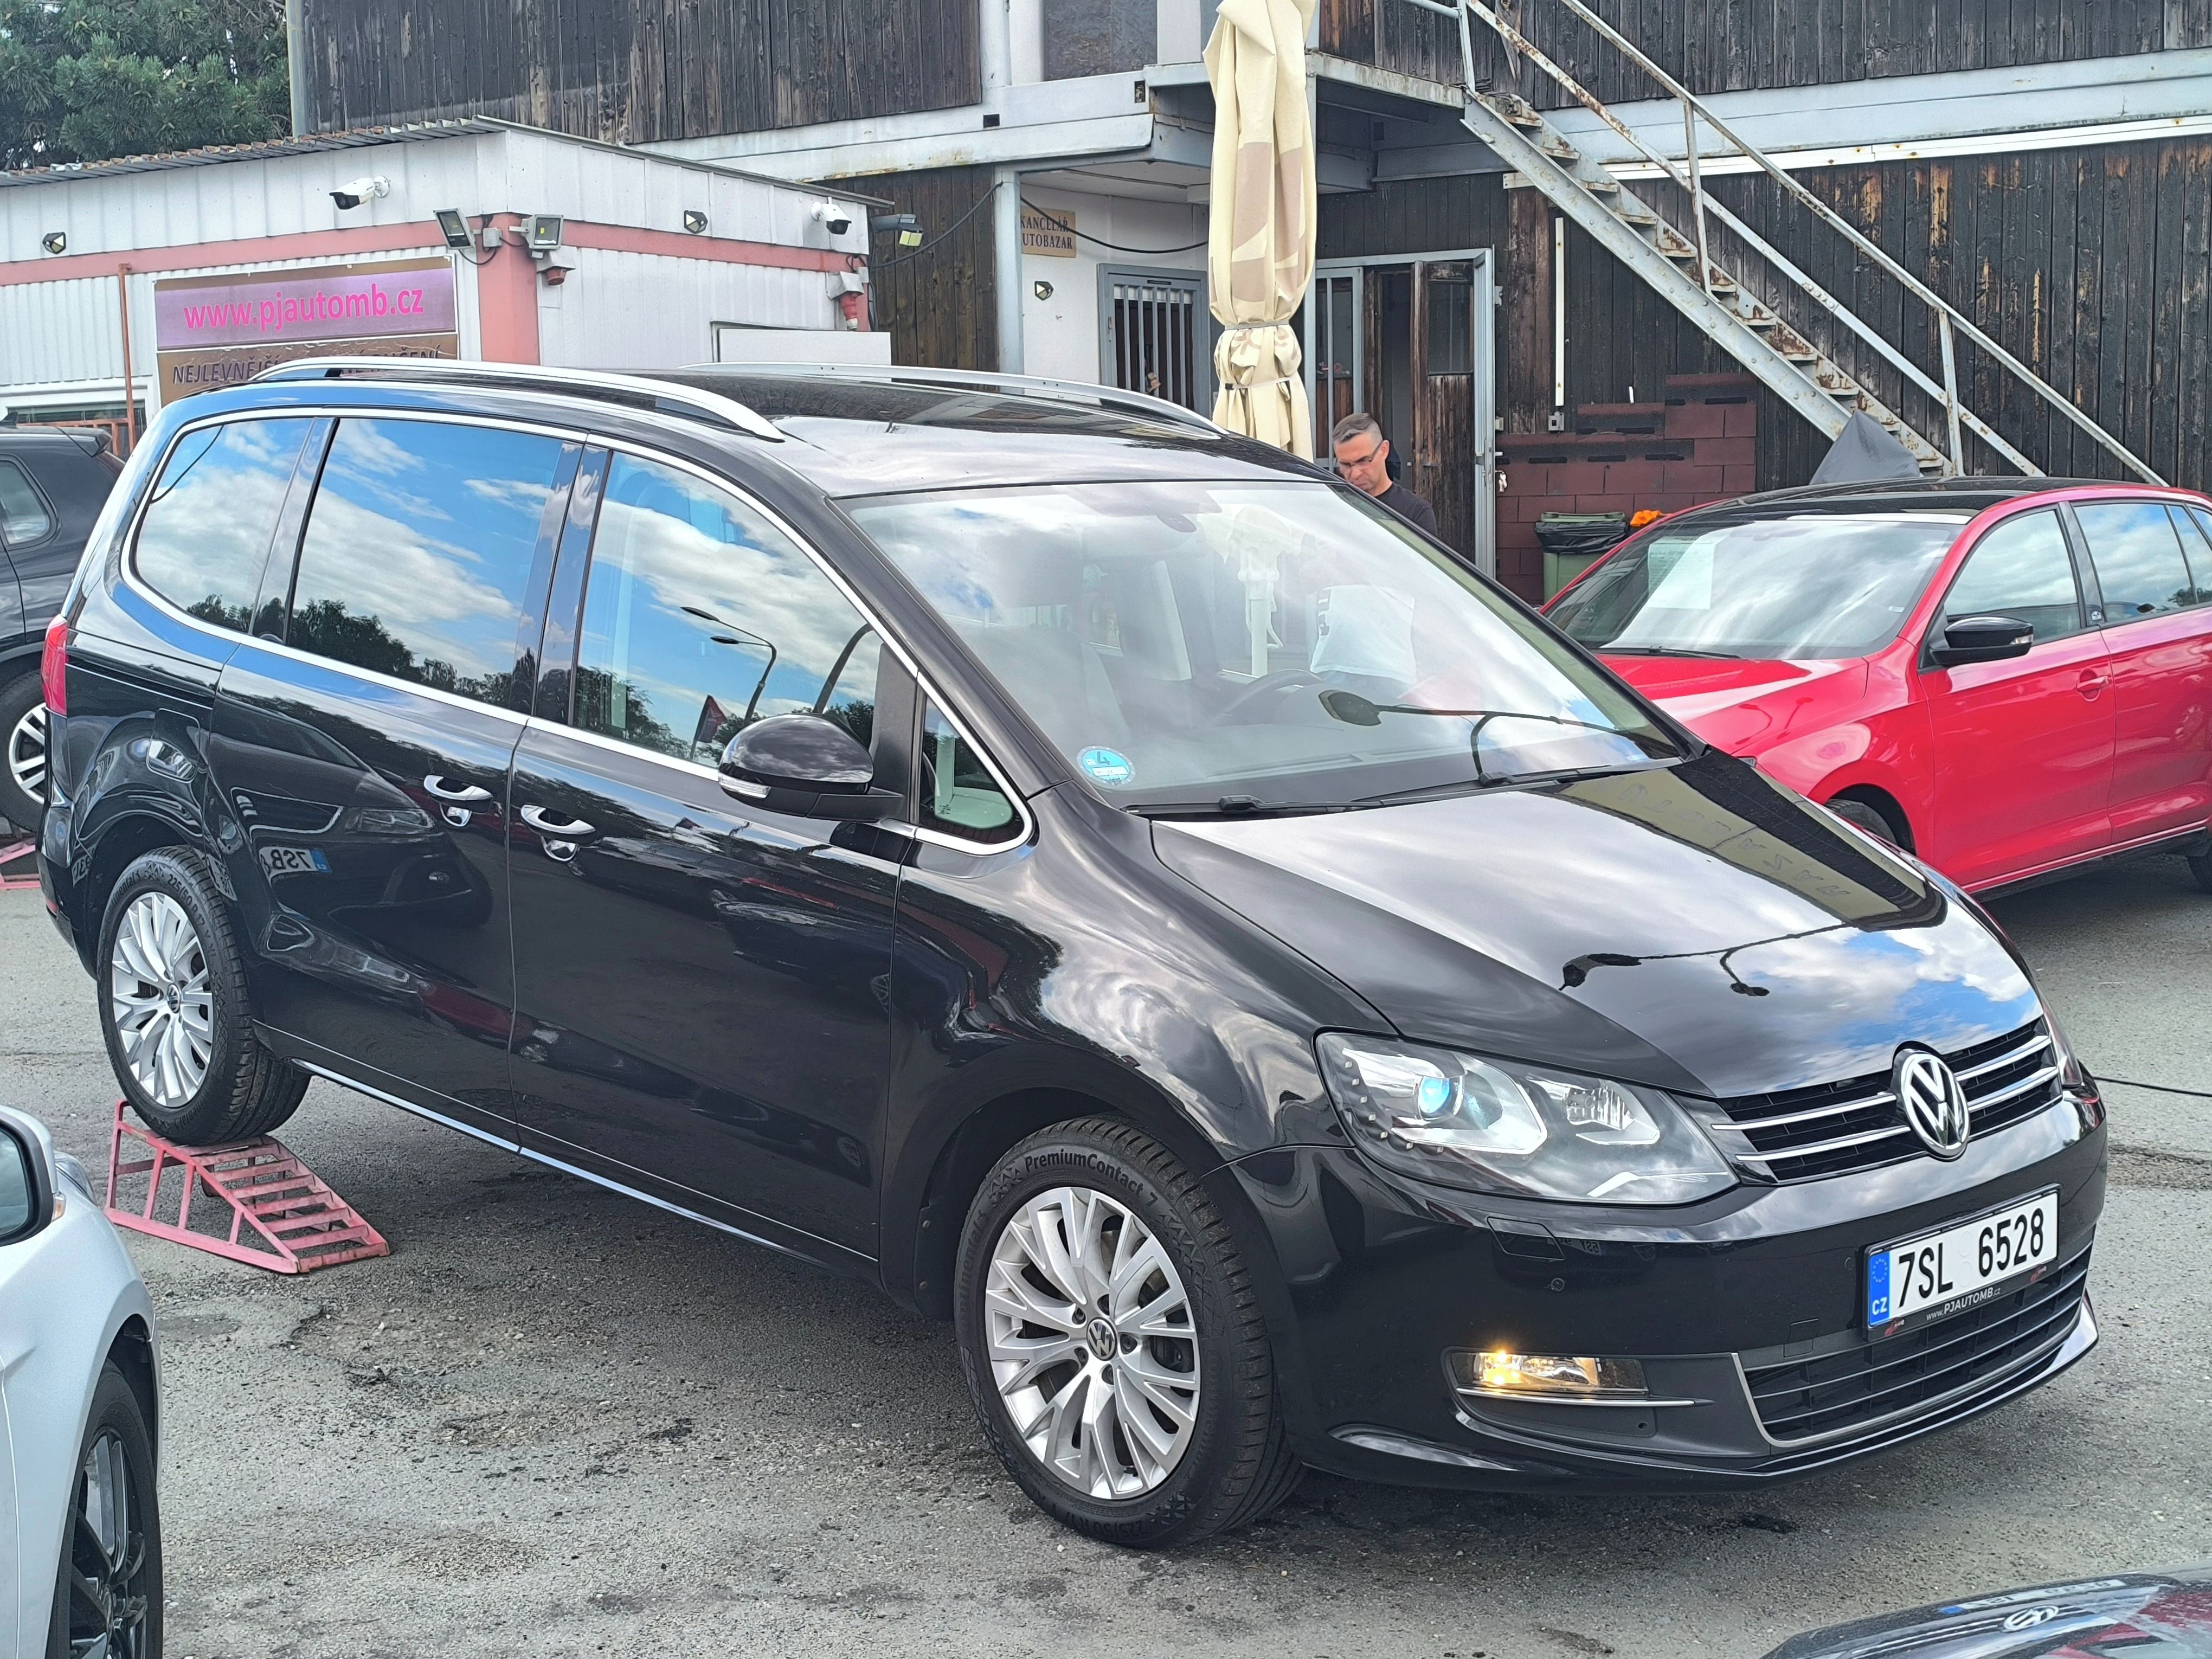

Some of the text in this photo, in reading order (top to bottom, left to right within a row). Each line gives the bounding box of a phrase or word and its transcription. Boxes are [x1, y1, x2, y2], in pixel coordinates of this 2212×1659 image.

[1022, 233, 1072, 249] UTOBAZAR
[183, 283, 424, 331] www.pjautomb.cz
[1025, 1148, 1159, 1207] PremiumContact 7
[1898, 1207, 2044, 1309] 7SL 6528
[1872, 1296, 1888, 1316] CZ
[1925, 1286, 2001, 1321] www.PJAUTOMB.cz
